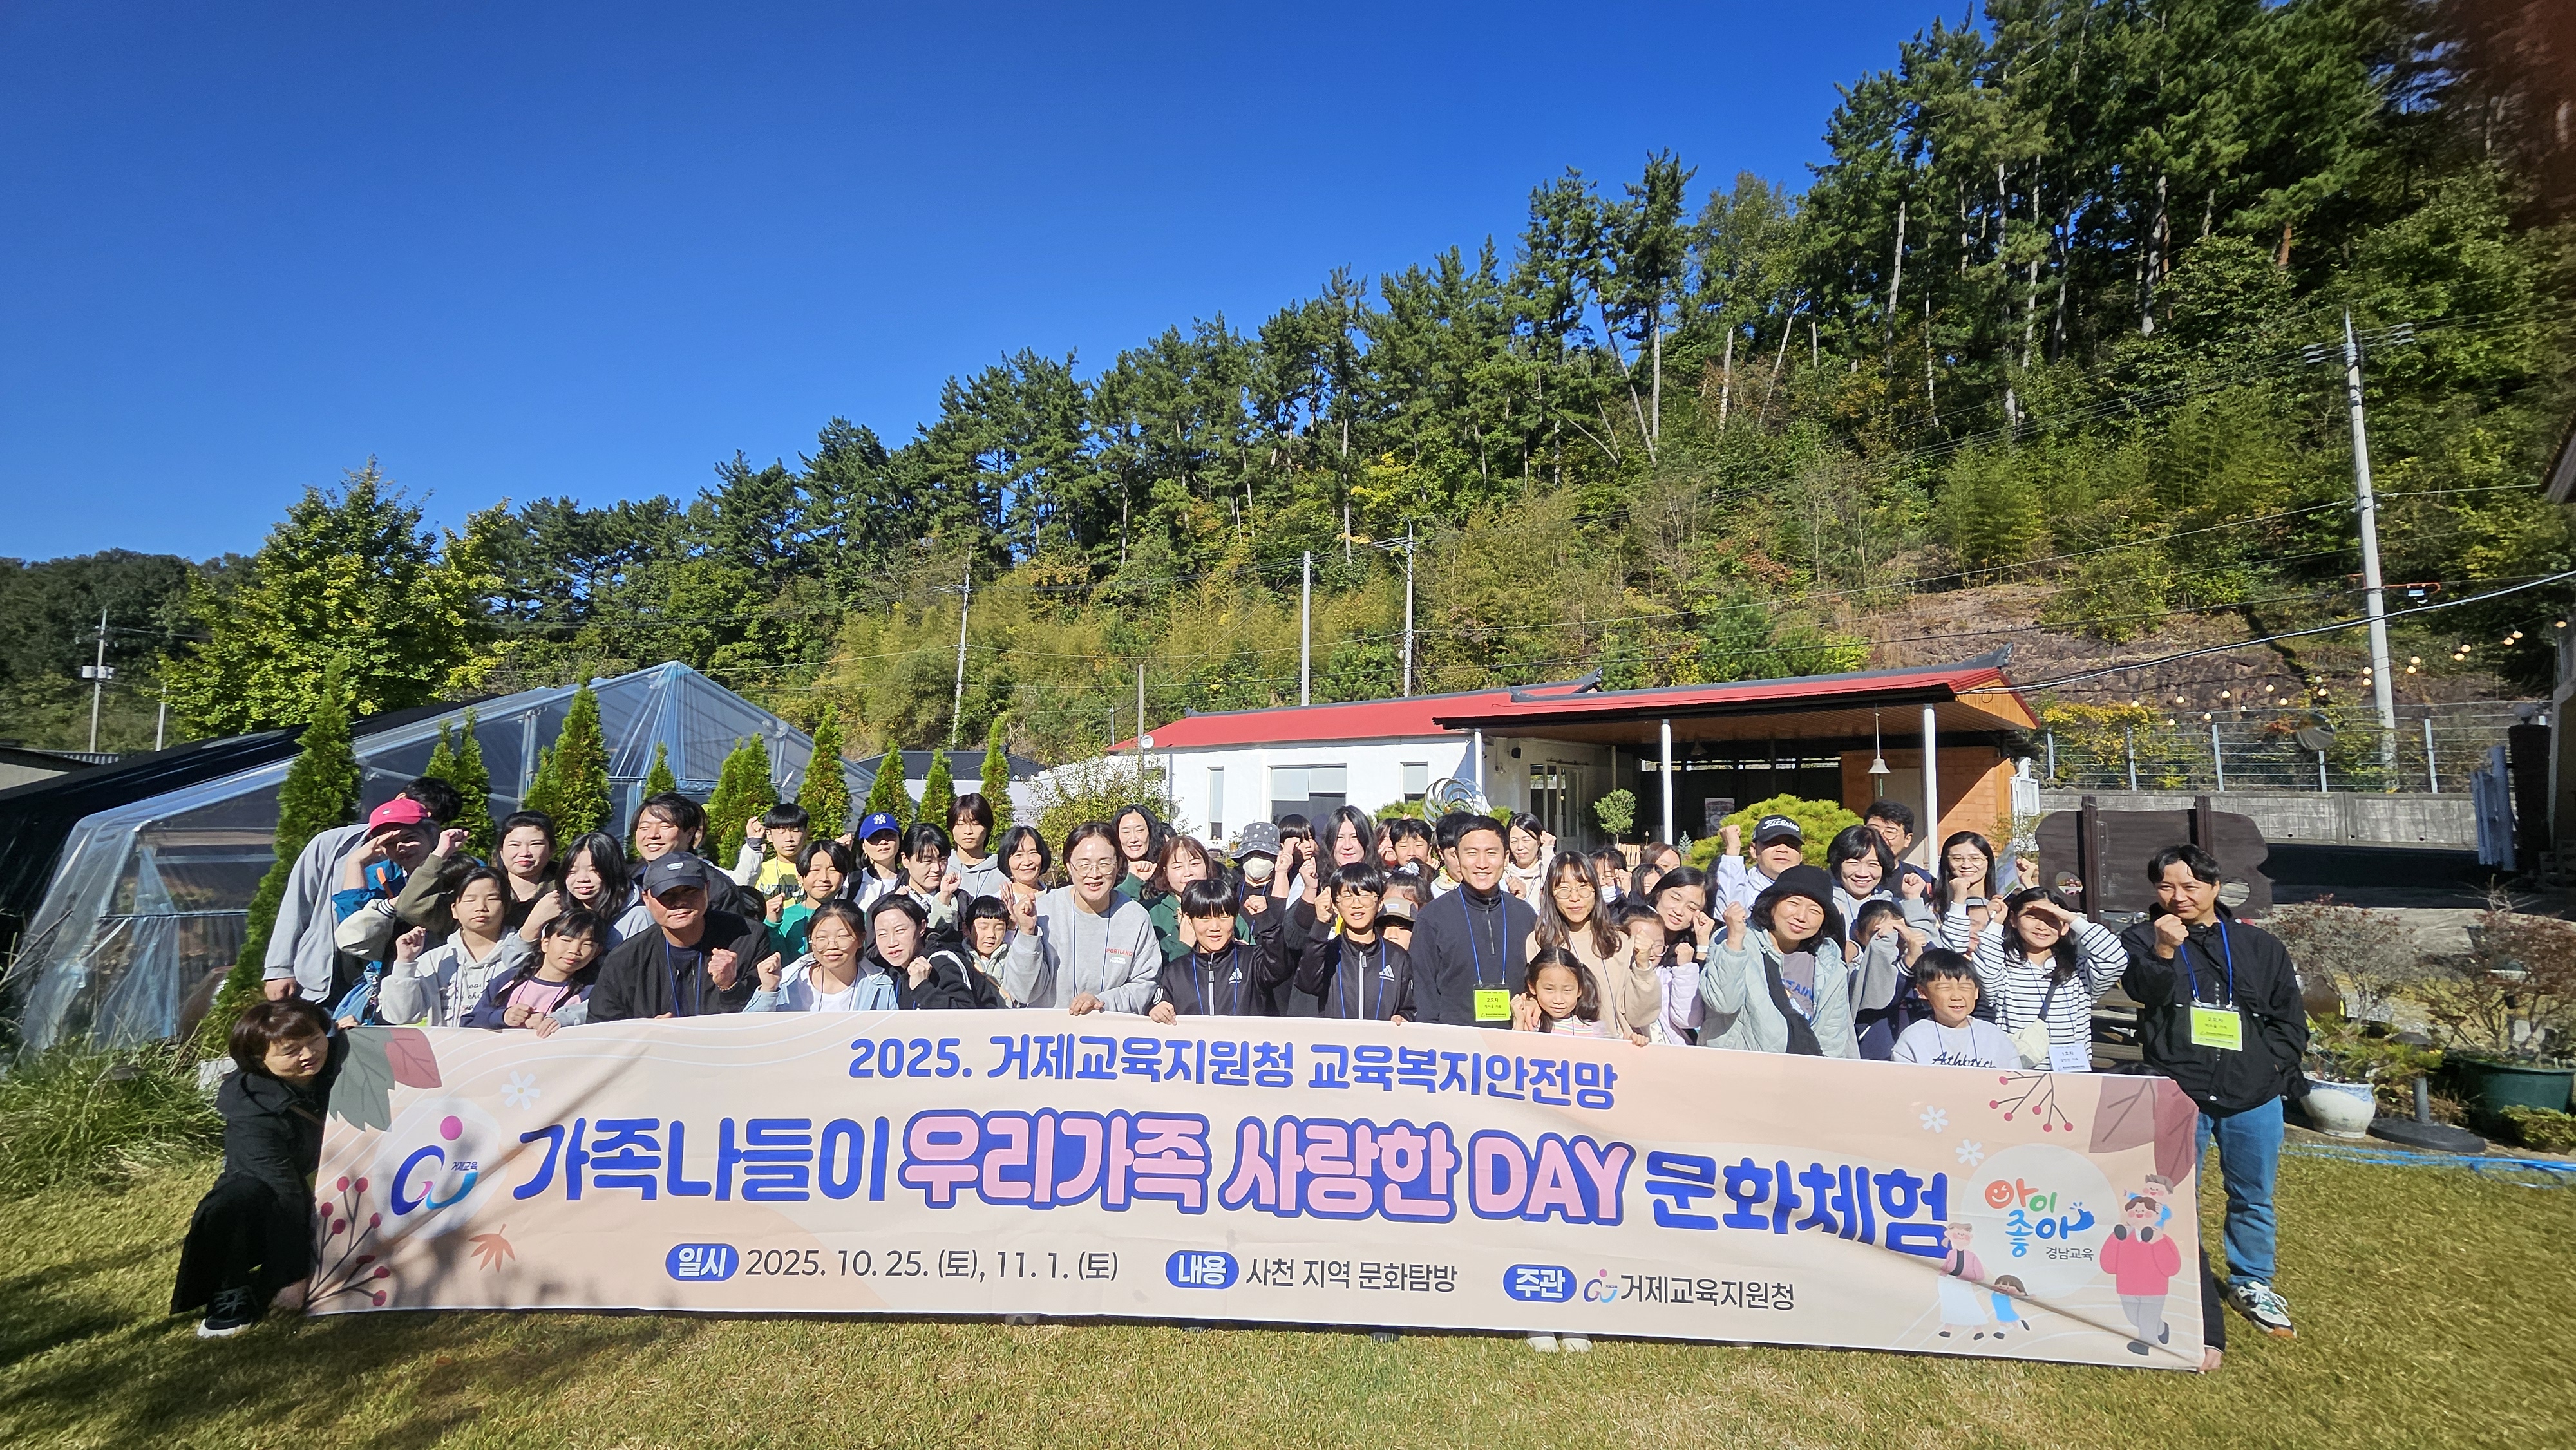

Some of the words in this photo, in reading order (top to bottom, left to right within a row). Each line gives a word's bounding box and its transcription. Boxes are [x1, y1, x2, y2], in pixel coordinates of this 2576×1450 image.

[873, 814, 887, 825] NY
[1106, 948, 1133, 956] PORTLAND
[849, 1037, 972, 1078] 2025.
[987, 1033, 1294, 1088] 거제교육지원청
[1308, 1044, 1618, 1110] 교육복지안전망
[451, 1161, 478, 1171] 거제교육
[513, 1116, 890, 1201] 가족나들이
[898, 1107, 1212, 1215] 우리가족
[1217, 1115, 1463, 1223] 사랑한
[1468, 1129, 1637, 1226] DAY
[1645, 1151, 1952, 1259] 문화체험
[1985, 1178, 2058, 1214] 아이
[2005, 1202, 2095, 1257] 좋아
[678, 1247, 727, 1277] 일시
[746, 1249, 825, 1276] 2025.
[838, 1250, 876, 1277] 10.
[886, 1250, 928, 1277] 25.
[938, 1248, 985, 1283] (토),
[996, 1251, 1036, 1278] 11.
[1048, 1252, 1068, 1279] 1.
[1078, 1251, 1119, 1281] (토)
[1178, 1254, 1227, 1285] 내용
[2046, 1247, 2094, 1261] 경남교육
[1245, 1258, 1294, 1287] 사천
[1302, 1259, 1350, 1289] 지역
[1358, 1261, 1458, 1292] 문화탐방
[1515, 1268, 1566, 1299] 주관
[1620, 1274, 1795, 1310] 거제교육지원청
